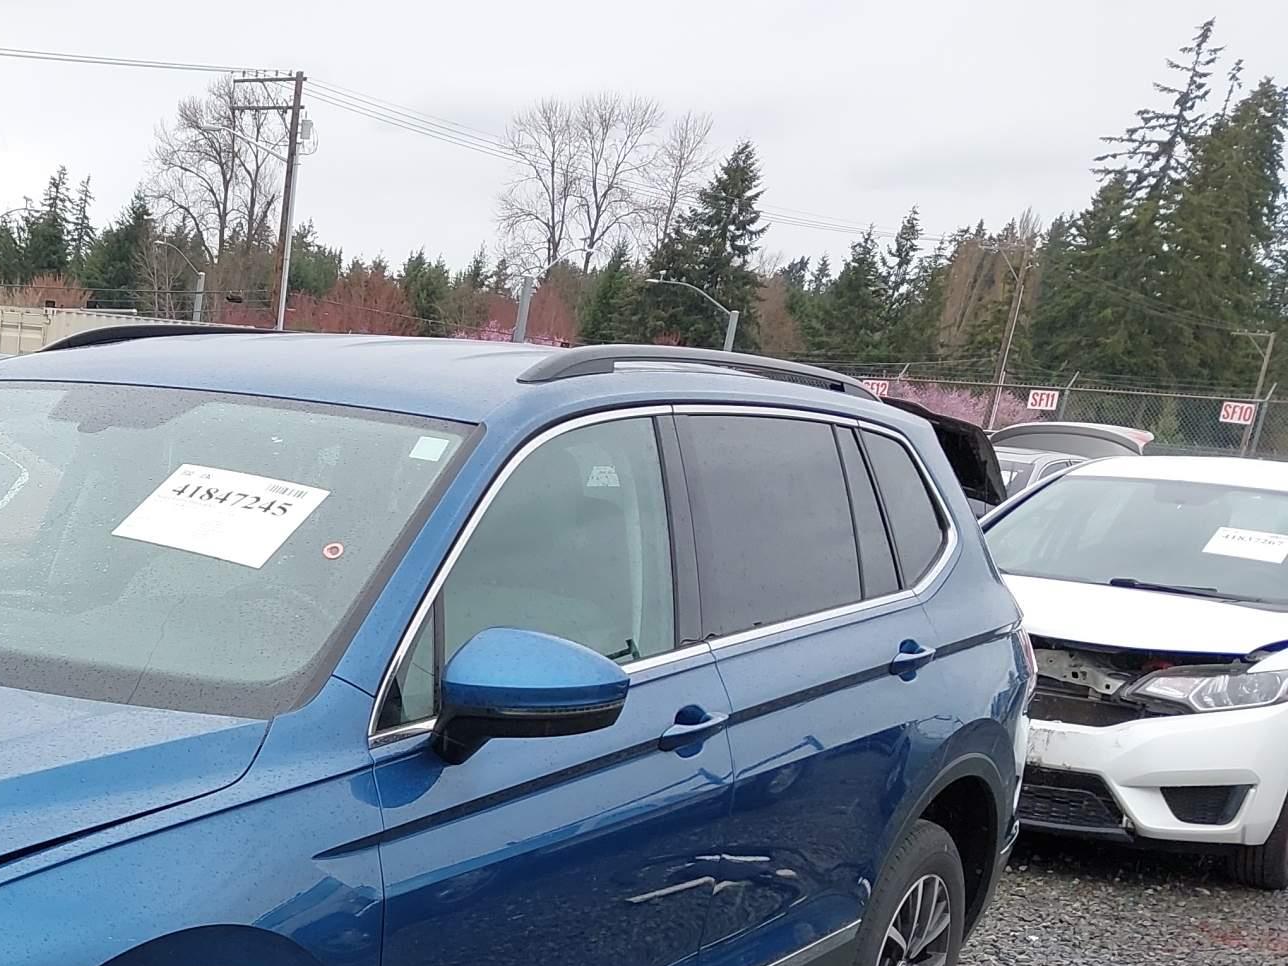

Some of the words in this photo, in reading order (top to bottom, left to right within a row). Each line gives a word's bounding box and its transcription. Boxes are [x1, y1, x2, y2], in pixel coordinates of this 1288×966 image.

[1030, 391, 1056, 408] SF11
[1222, 403, 1253, 422] SF10
[172, 483, 293, 516] 41847245
